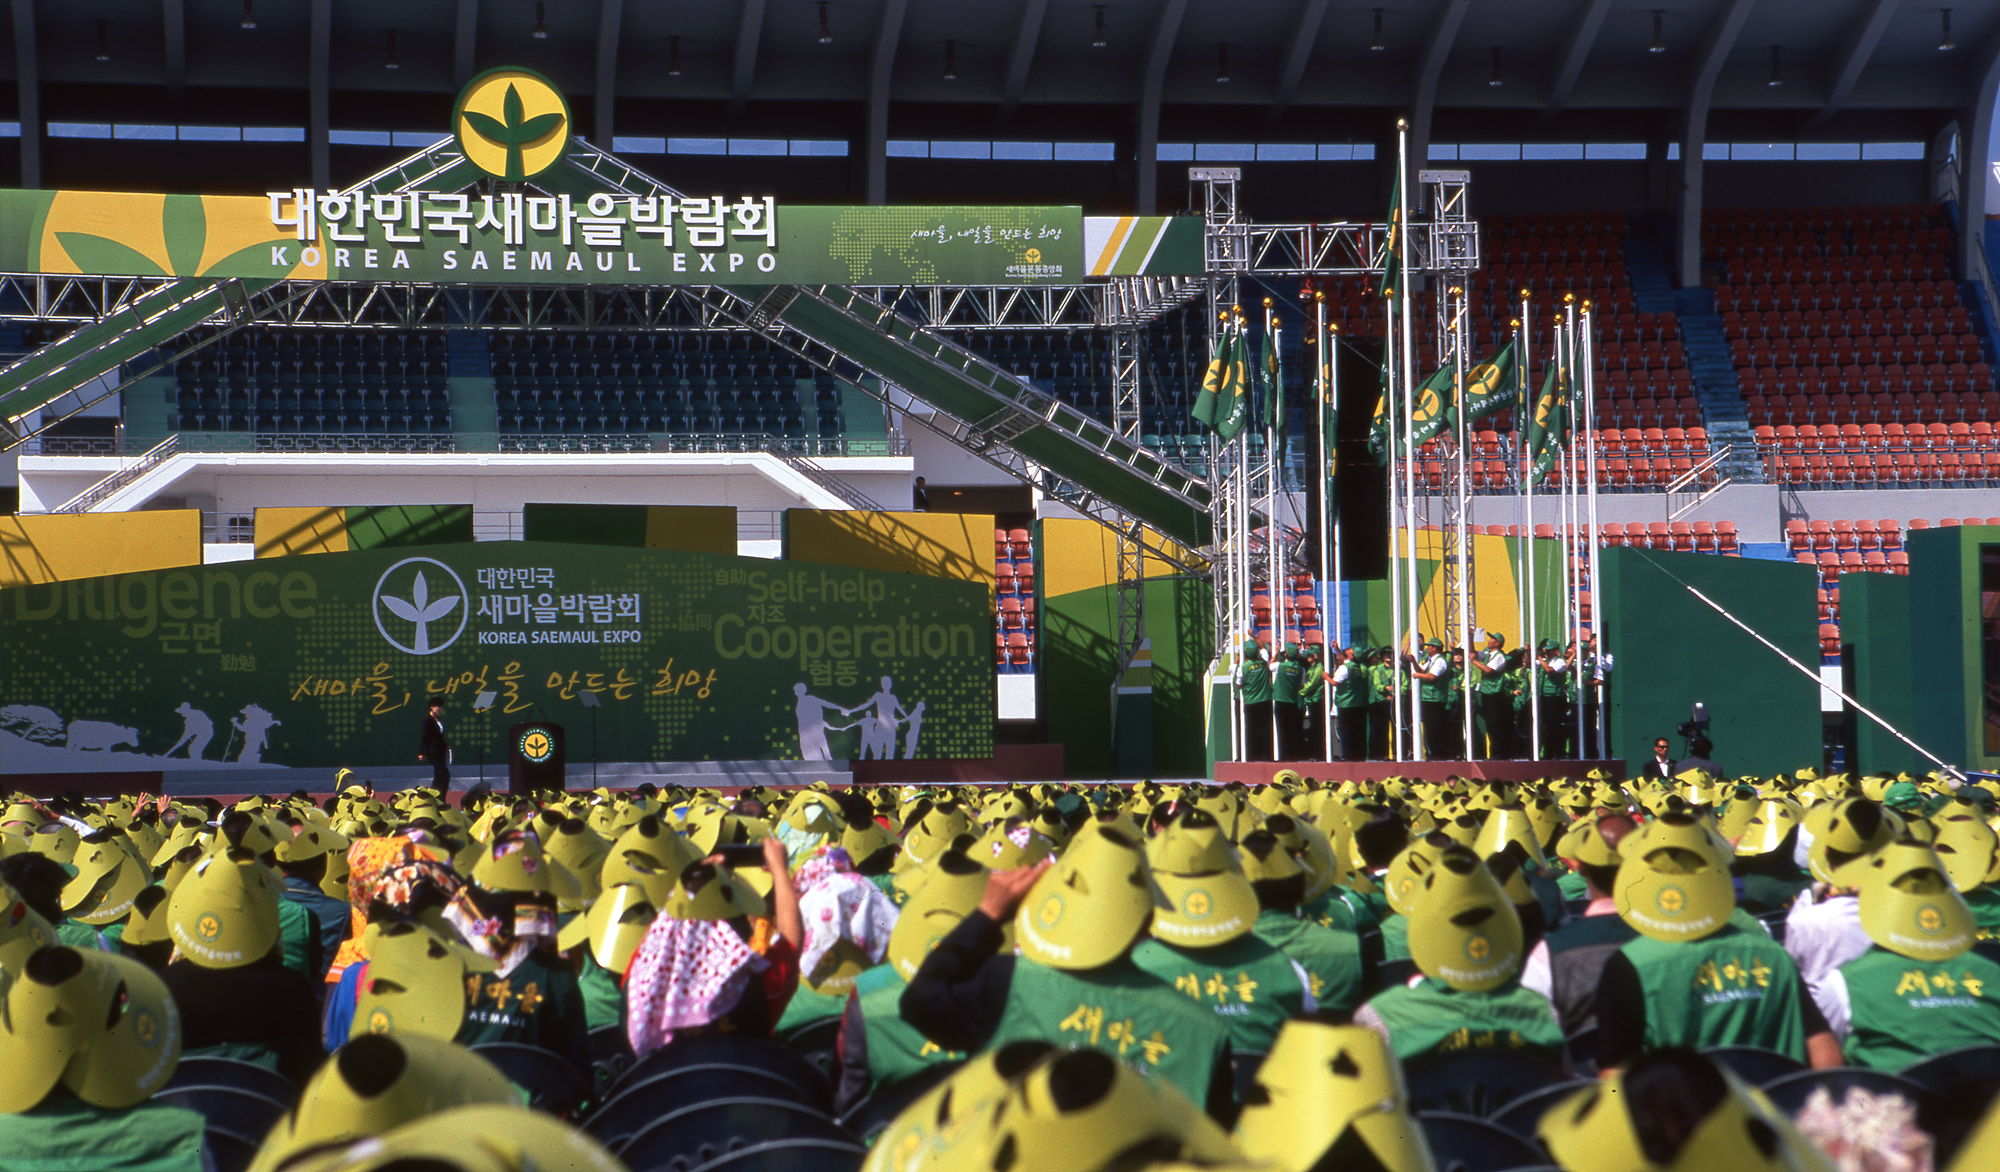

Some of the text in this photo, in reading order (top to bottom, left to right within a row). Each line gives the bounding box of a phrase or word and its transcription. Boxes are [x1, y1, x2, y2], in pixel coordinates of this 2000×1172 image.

[266, 187, 775, 247] 대한민국새마을박람회
[910, 224, 1062, 244] 새마을, 내일을 만드는 희망
[271, 246, 776, 273] KOREA SAEMAUL EXPO
[476, 567, 555, 589] 대한민국
[715, 568, 748, 586] 自助
[747, 570, 885, 611] Self-help
[14, 569, 318, 638] Diligence
[476, 593, 641, 625] 새마을박람회
[747, 603, 786, 624] 자조
[158, 618, 223, 654] 근면
[677, 613, 712, 632] 協同
[478, 630, 642, 645] KOREA SAEMAUL EXPO
[714, 613, 975, 671] Cooperation
[291, 657, 718, 715] 새마을, 내일을 만드는 희망
[809, 660, 859, 687] 협동
